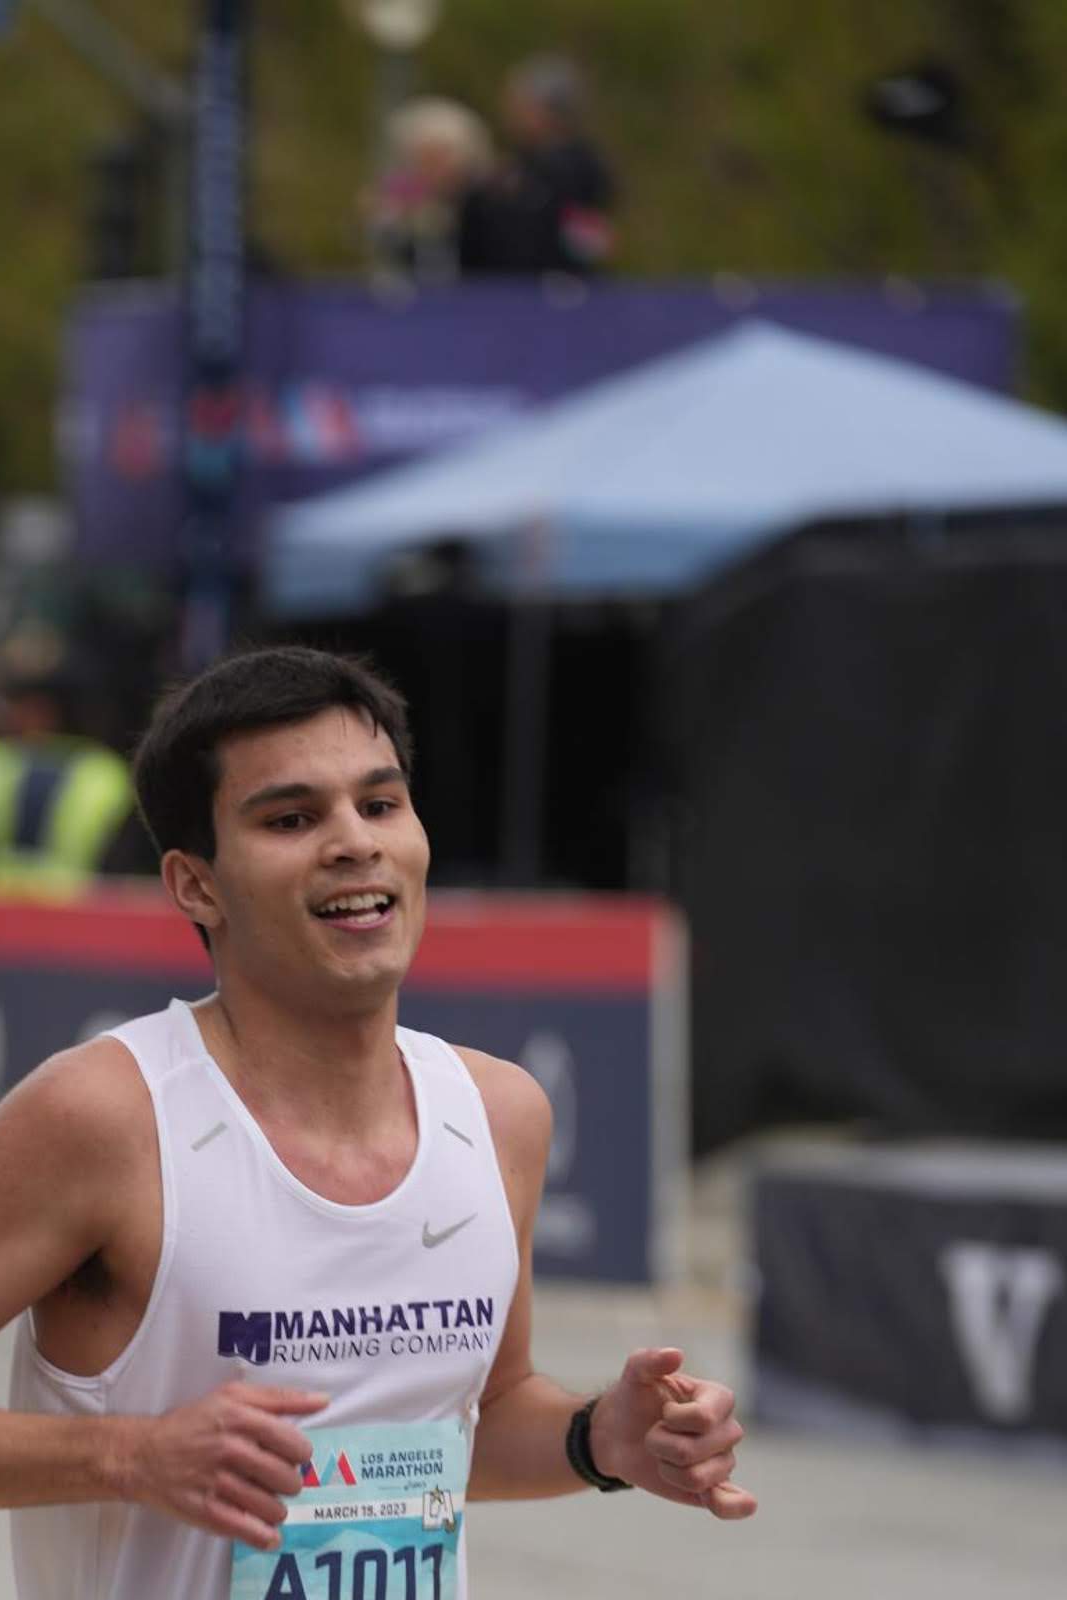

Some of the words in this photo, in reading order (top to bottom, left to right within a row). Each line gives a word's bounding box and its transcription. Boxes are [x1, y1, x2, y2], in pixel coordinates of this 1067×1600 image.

[274, 1297, 493, 1340] MANHATTAN
[272, 1338, 380, 1363] RUNNING
[390, 1330, 493, 1356] COMPANY
[360, 1452, 384, 1465] LOS
[388, 1448, 443, 1462] ANGELES
[361, 1461, 444, 1480] MARATHON
[314, 1504, 358, 1520] MARCH
[380, 1501, 407, 1516] 2023
